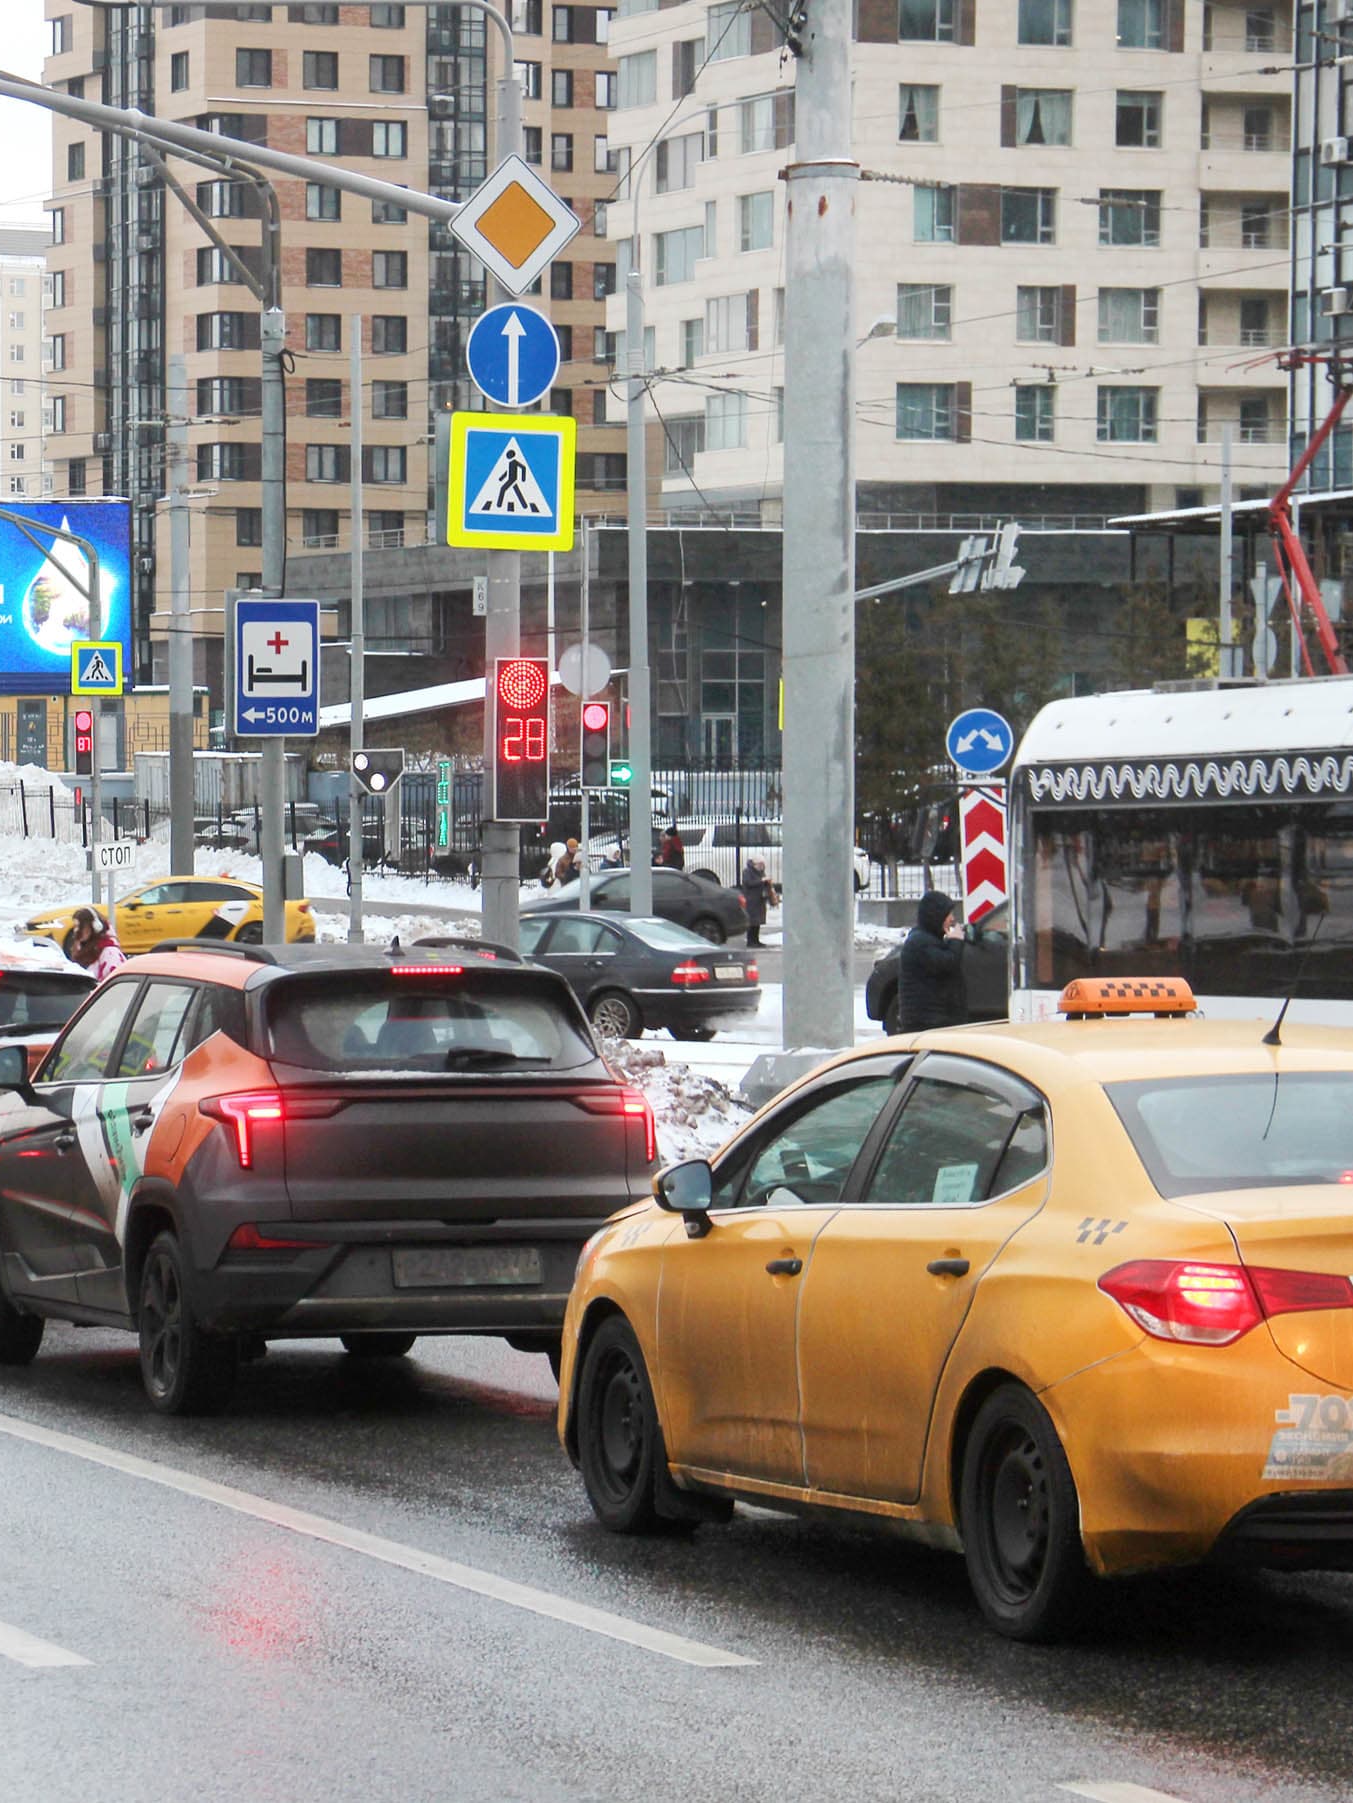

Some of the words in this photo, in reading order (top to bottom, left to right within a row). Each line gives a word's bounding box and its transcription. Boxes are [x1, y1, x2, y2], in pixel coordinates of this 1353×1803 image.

[78, 736, 91, 752] 87
[504, 718, 544, 760] 28
[101, 846, 131, 866] СТОП
